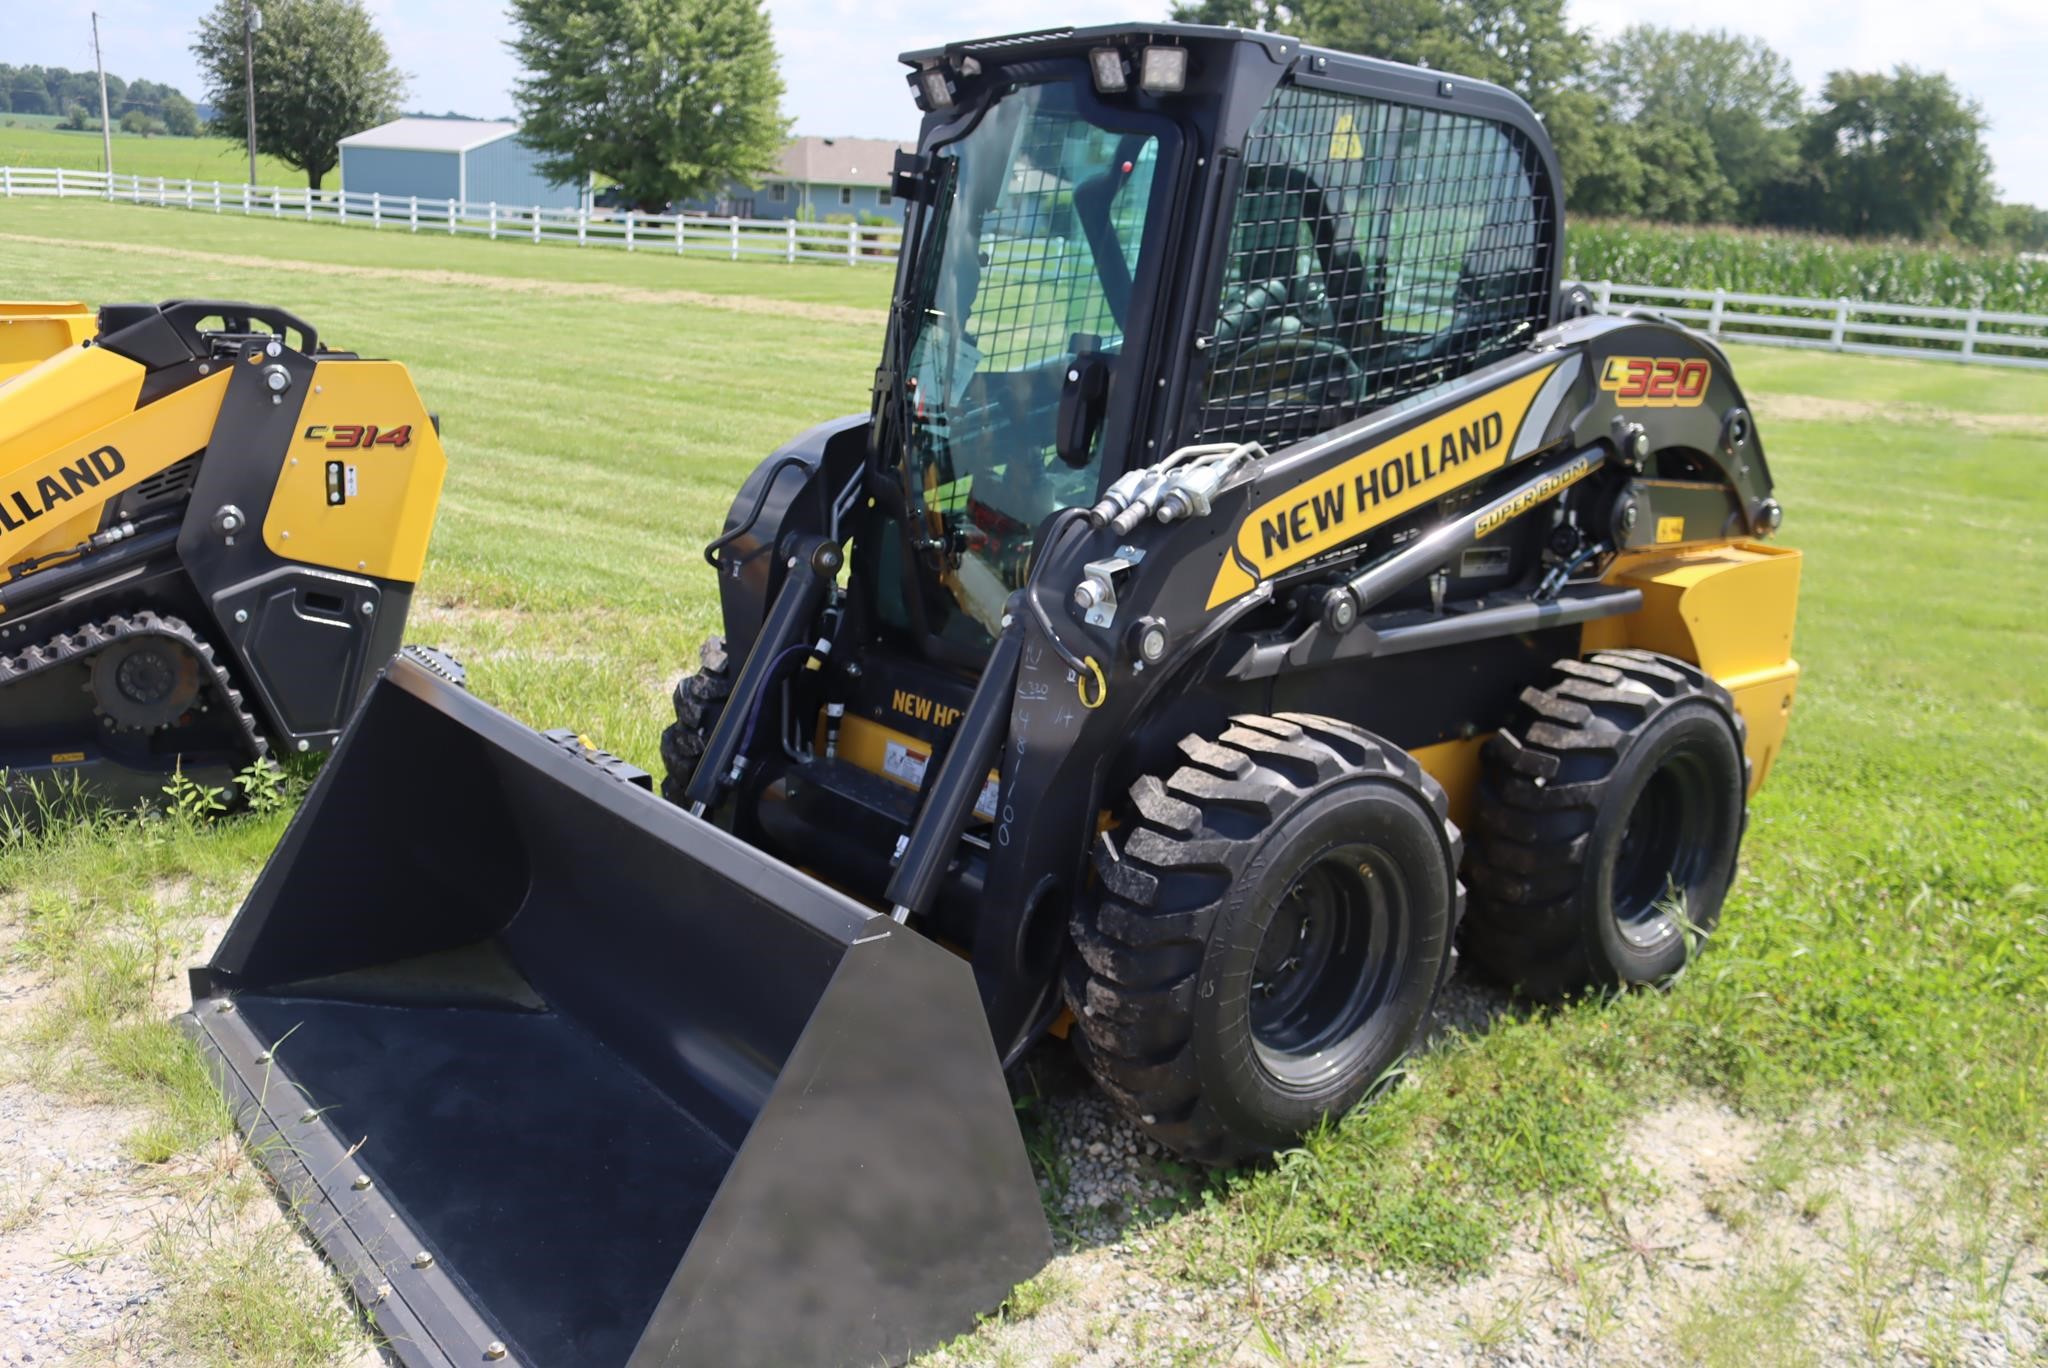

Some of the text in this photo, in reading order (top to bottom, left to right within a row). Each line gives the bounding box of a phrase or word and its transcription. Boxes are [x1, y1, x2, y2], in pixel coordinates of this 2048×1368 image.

[1602, 358, 1708, 399] L320
[304, 425, 412, 448] C314
[0, 445, 125, 536] LLAND
[1260, 411, 1503, 559] NEW HOLLAND
[892, 689, 961, 728] NEW HO
